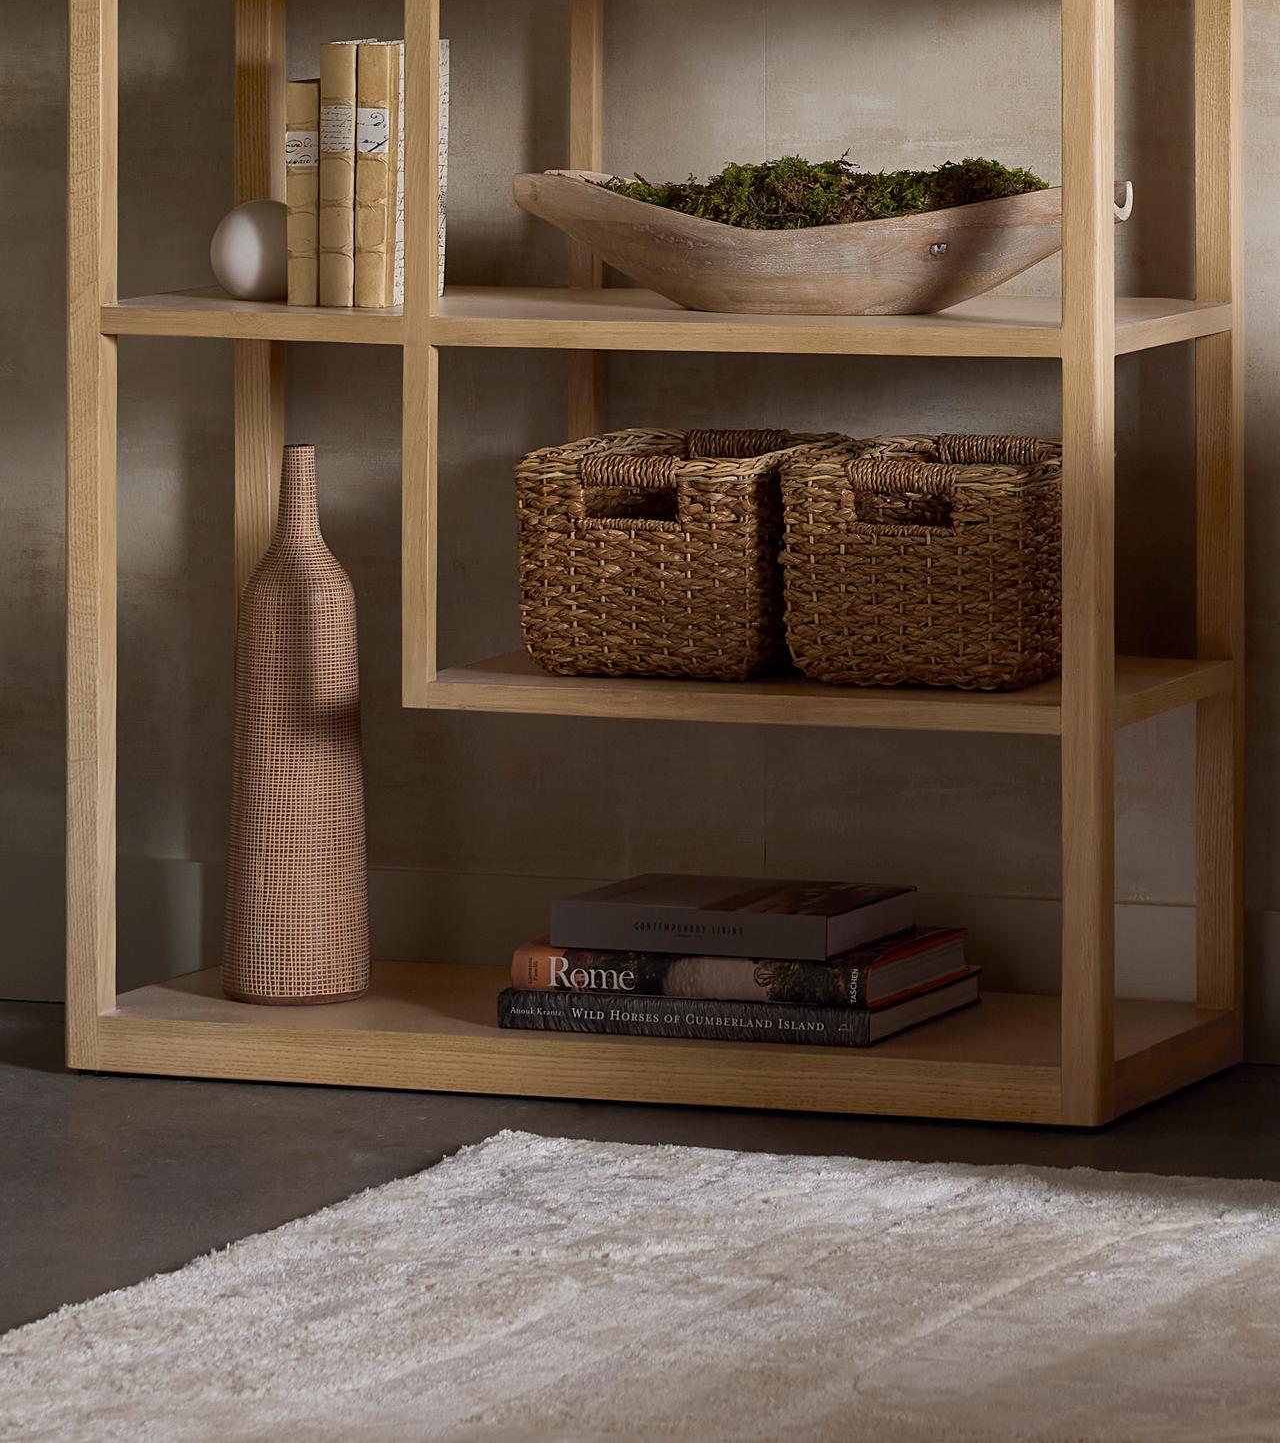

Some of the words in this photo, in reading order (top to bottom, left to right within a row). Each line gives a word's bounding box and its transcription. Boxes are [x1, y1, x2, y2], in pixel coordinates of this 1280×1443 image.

[547, 956, 637, 991] Rome
[850, 968, 859, 1004] TASCHEN
[510, 1006, 534, 1015] Anouk
[571, 1007, 605, 1020] WILD
[610, 1009, 660, 1023] HORSES
[664, 1013, 681, 1025] OF
[685, 1013, 773, 1029] CUMBERLAND
[778, 1018, 825, 1032] ISLAND
